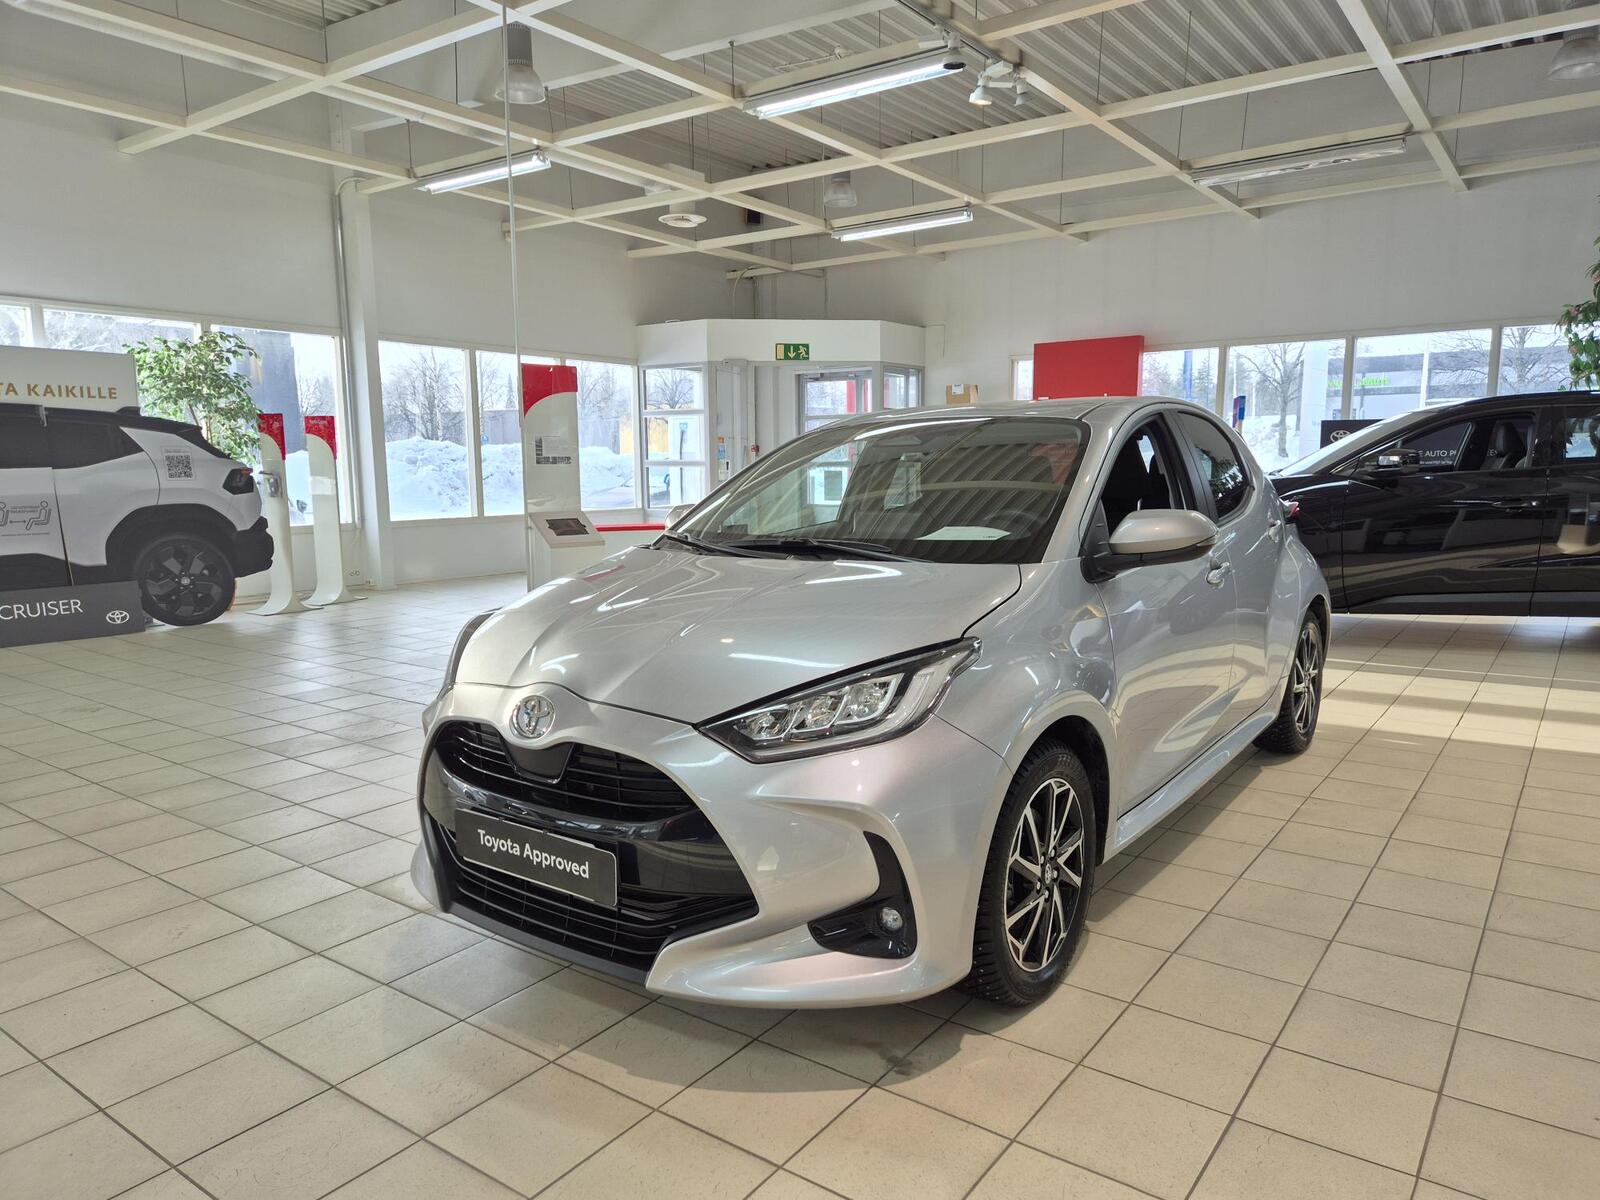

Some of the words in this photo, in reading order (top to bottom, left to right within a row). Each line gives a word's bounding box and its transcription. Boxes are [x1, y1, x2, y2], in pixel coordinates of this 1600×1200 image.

[26, 383, 118, 400] KAIKILLE
[1424, 449, 1448, 458] AUTO
[0, 598, 84, 620] CRUISER
[477, 828, 521, 857] Toyota
[523, 842, 590, 880] Approved
